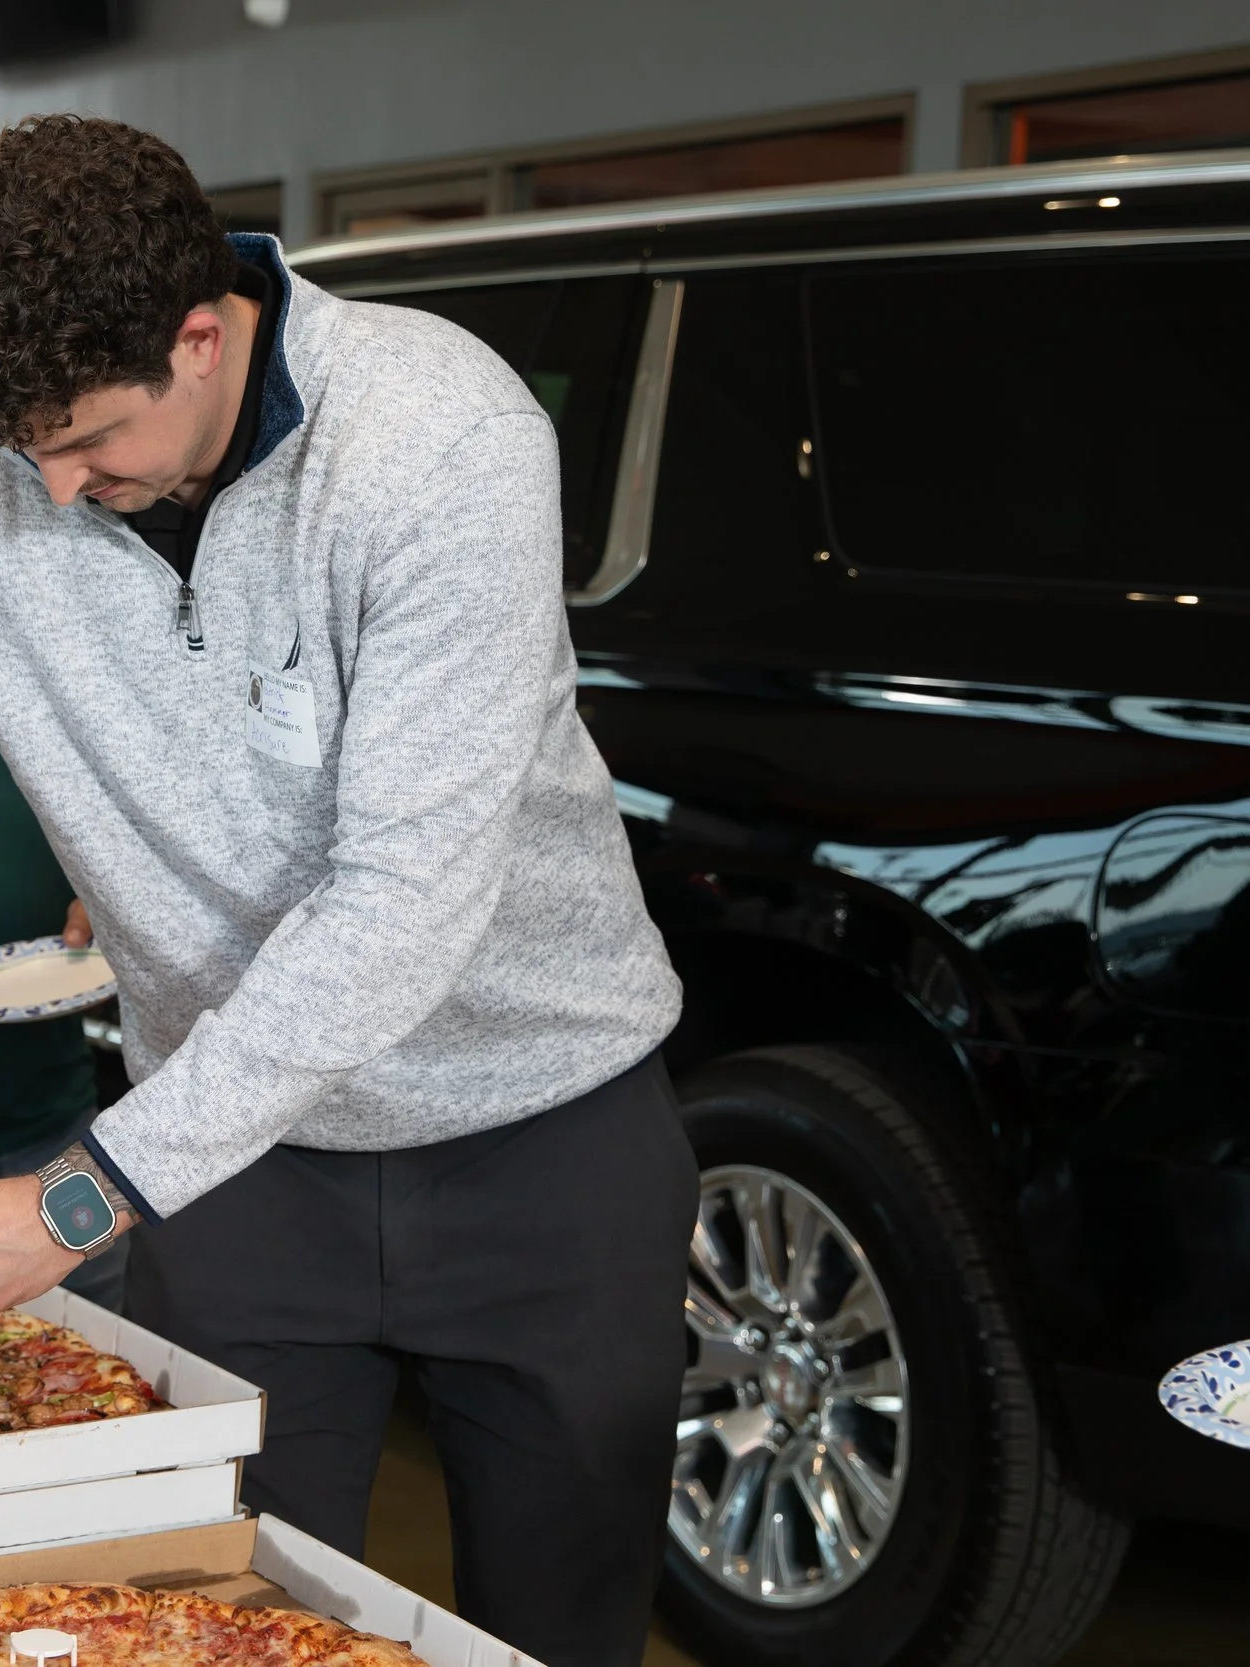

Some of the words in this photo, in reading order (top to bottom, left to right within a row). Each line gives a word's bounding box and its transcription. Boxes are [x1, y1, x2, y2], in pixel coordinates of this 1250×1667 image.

[282, 679, 299, 692] NAME
[299, 684, 307, 694] IS:
[270, 717, 295, 732] COMPANY
